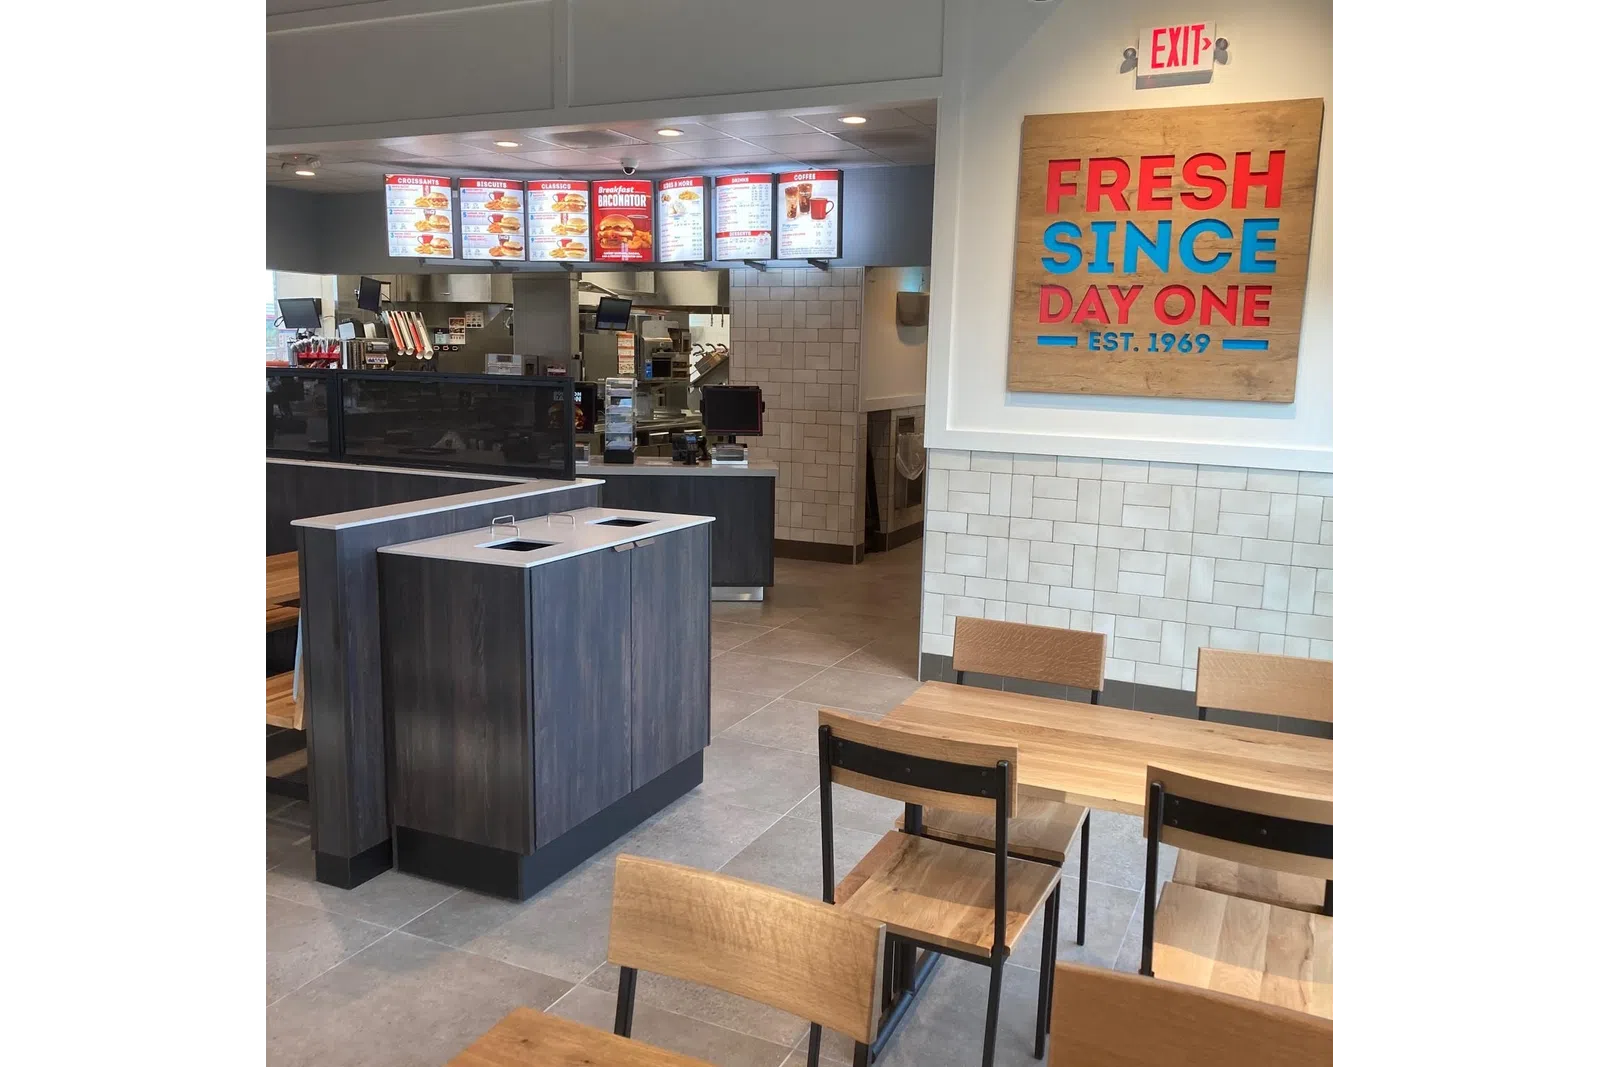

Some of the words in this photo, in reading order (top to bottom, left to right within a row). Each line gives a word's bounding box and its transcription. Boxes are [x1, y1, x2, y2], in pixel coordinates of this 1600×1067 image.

[1151, 24, 1205, 69] EXIT
[397, 177, 440, 186] CROISSANTS
[793, 173, 816, 181] COFFEE
[1045, 149, 1286, 214] FRESH
[598, 185, 635, 196] Breakfast
[598, 194, 647, 207] BACONATOR
[1041, 218, 1280, 274] SINCE
[1038, 284, 1144, 325] DAY
[1153, 284, 1272, 327] ONE
[1087, 331, 1139, 352] EST.
[1148, 332, 1211, 354] 1969
